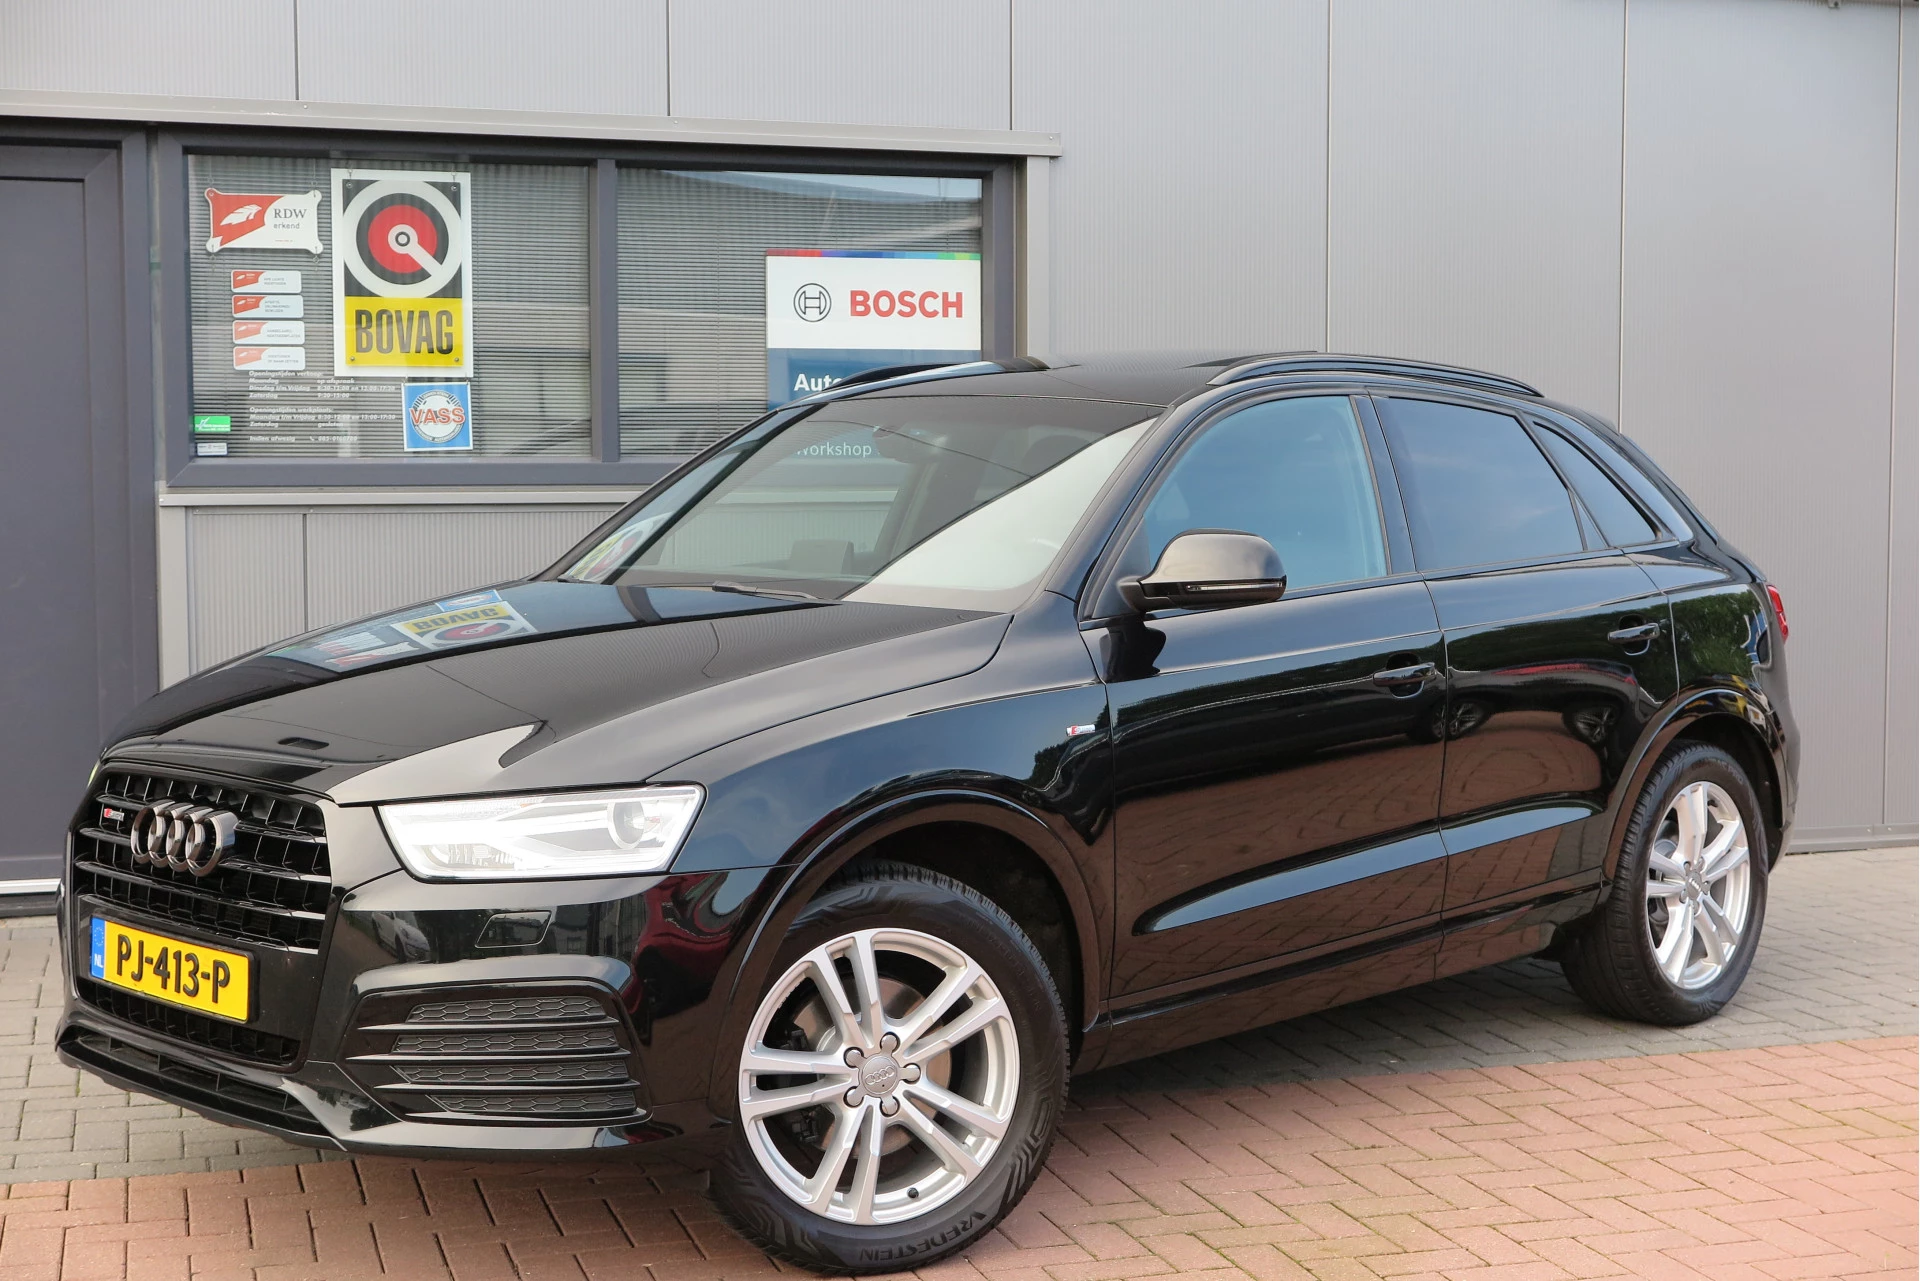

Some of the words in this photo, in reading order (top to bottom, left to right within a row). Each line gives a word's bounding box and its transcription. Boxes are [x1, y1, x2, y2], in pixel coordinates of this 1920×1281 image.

[273, 208, 307, 219] RDW
[273, 222, 300, 230] erkend
[850, 290, 963, 318] BOSCH
[355, 309, 454, 354] BOVAG
[409, 407, 466, 425] VASS
[94, 953, 104, 967] NL
[116, 933, 231, 1004] PJ-413-P
[859, 1210, 987, 1261] VREDESTEIN
